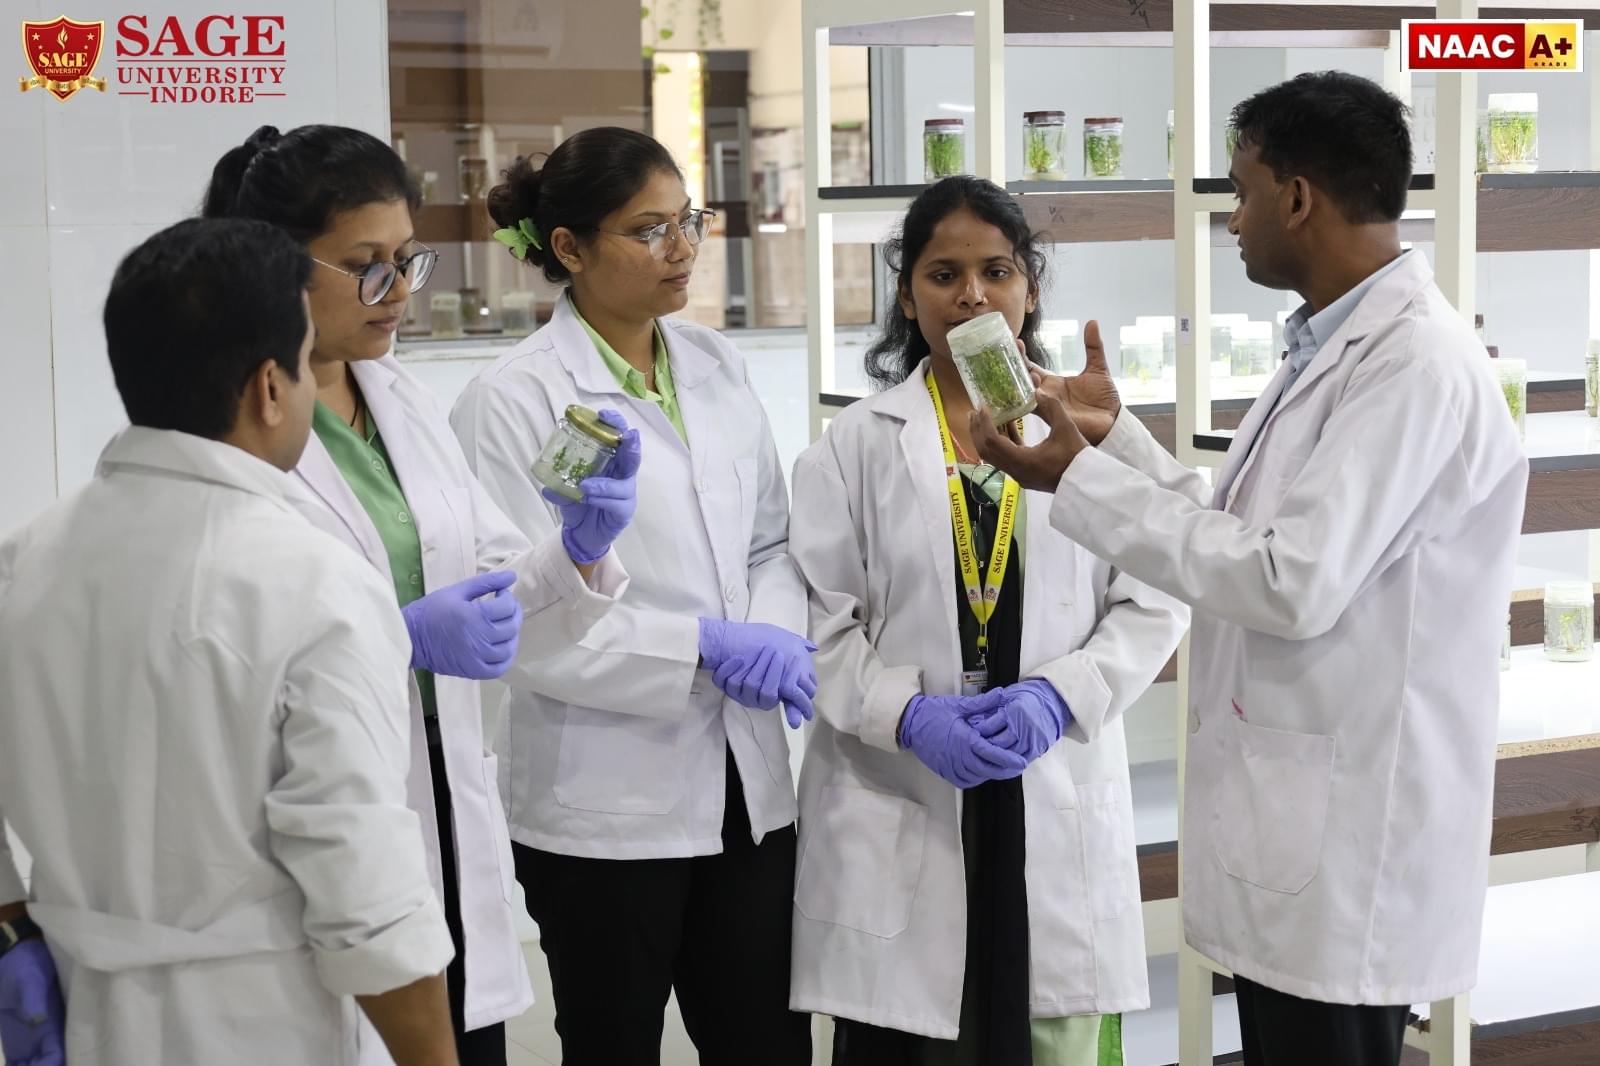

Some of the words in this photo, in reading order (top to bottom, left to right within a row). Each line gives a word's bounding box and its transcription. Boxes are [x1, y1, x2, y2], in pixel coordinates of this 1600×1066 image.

[950, 491, 967, 547] UNIVERSITY
[998, 491, 1014, 547] UNIVERSITY
[961, 548, 972, 574] SAGE
[993, 547, 1005, 574] SAGE
